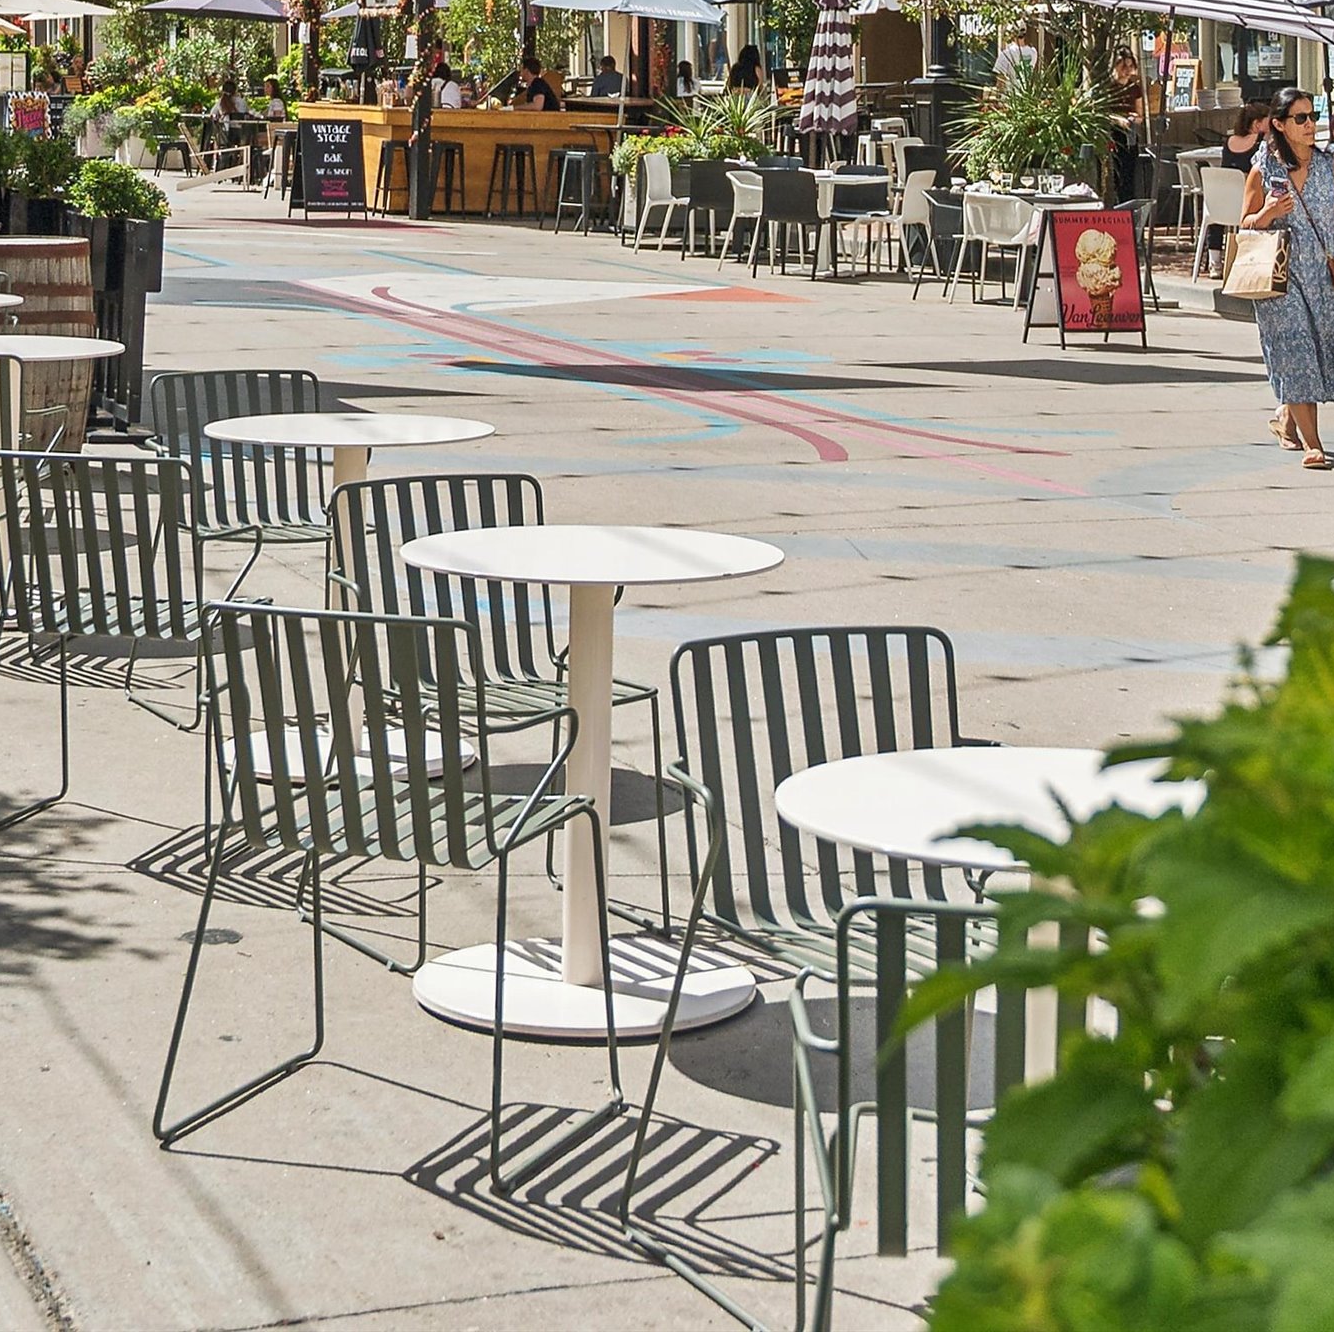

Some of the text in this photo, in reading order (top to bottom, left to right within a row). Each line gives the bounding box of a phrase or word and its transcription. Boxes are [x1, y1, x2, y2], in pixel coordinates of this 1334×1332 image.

[312, 124, 351, 135] VINTAGE
[317, 134, 347, 143] STORE
[323, 153, 343, 163] BAR
[1063, 303, 1087, 324] Van
